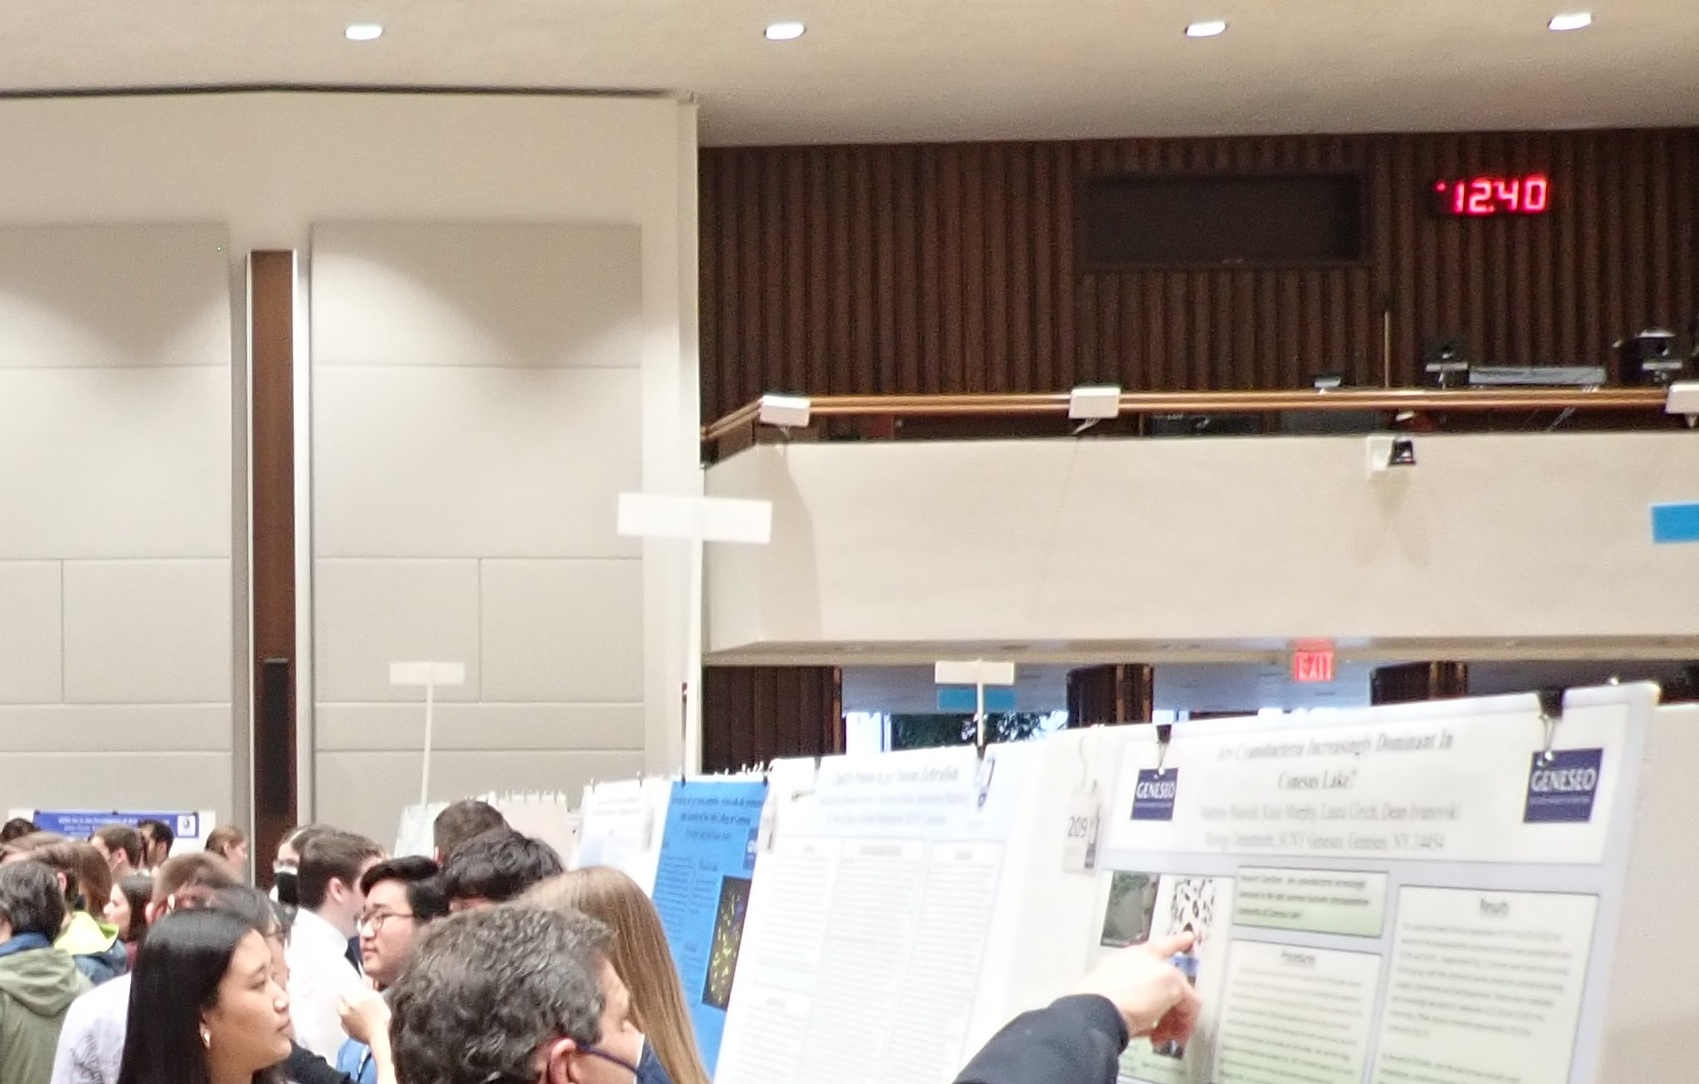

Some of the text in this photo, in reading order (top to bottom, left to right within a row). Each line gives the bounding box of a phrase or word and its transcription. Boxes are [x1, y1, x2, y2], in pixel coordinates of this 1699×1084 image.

[1295, 652, 1333, 681] EXIT
[1375, 733, 1437, 753] Dominant
[1136, 782, 1175, 799] GENESEO
[1530, 768, 1598, 792] GENESEO
[1067, 815, 1088, 838] 209
